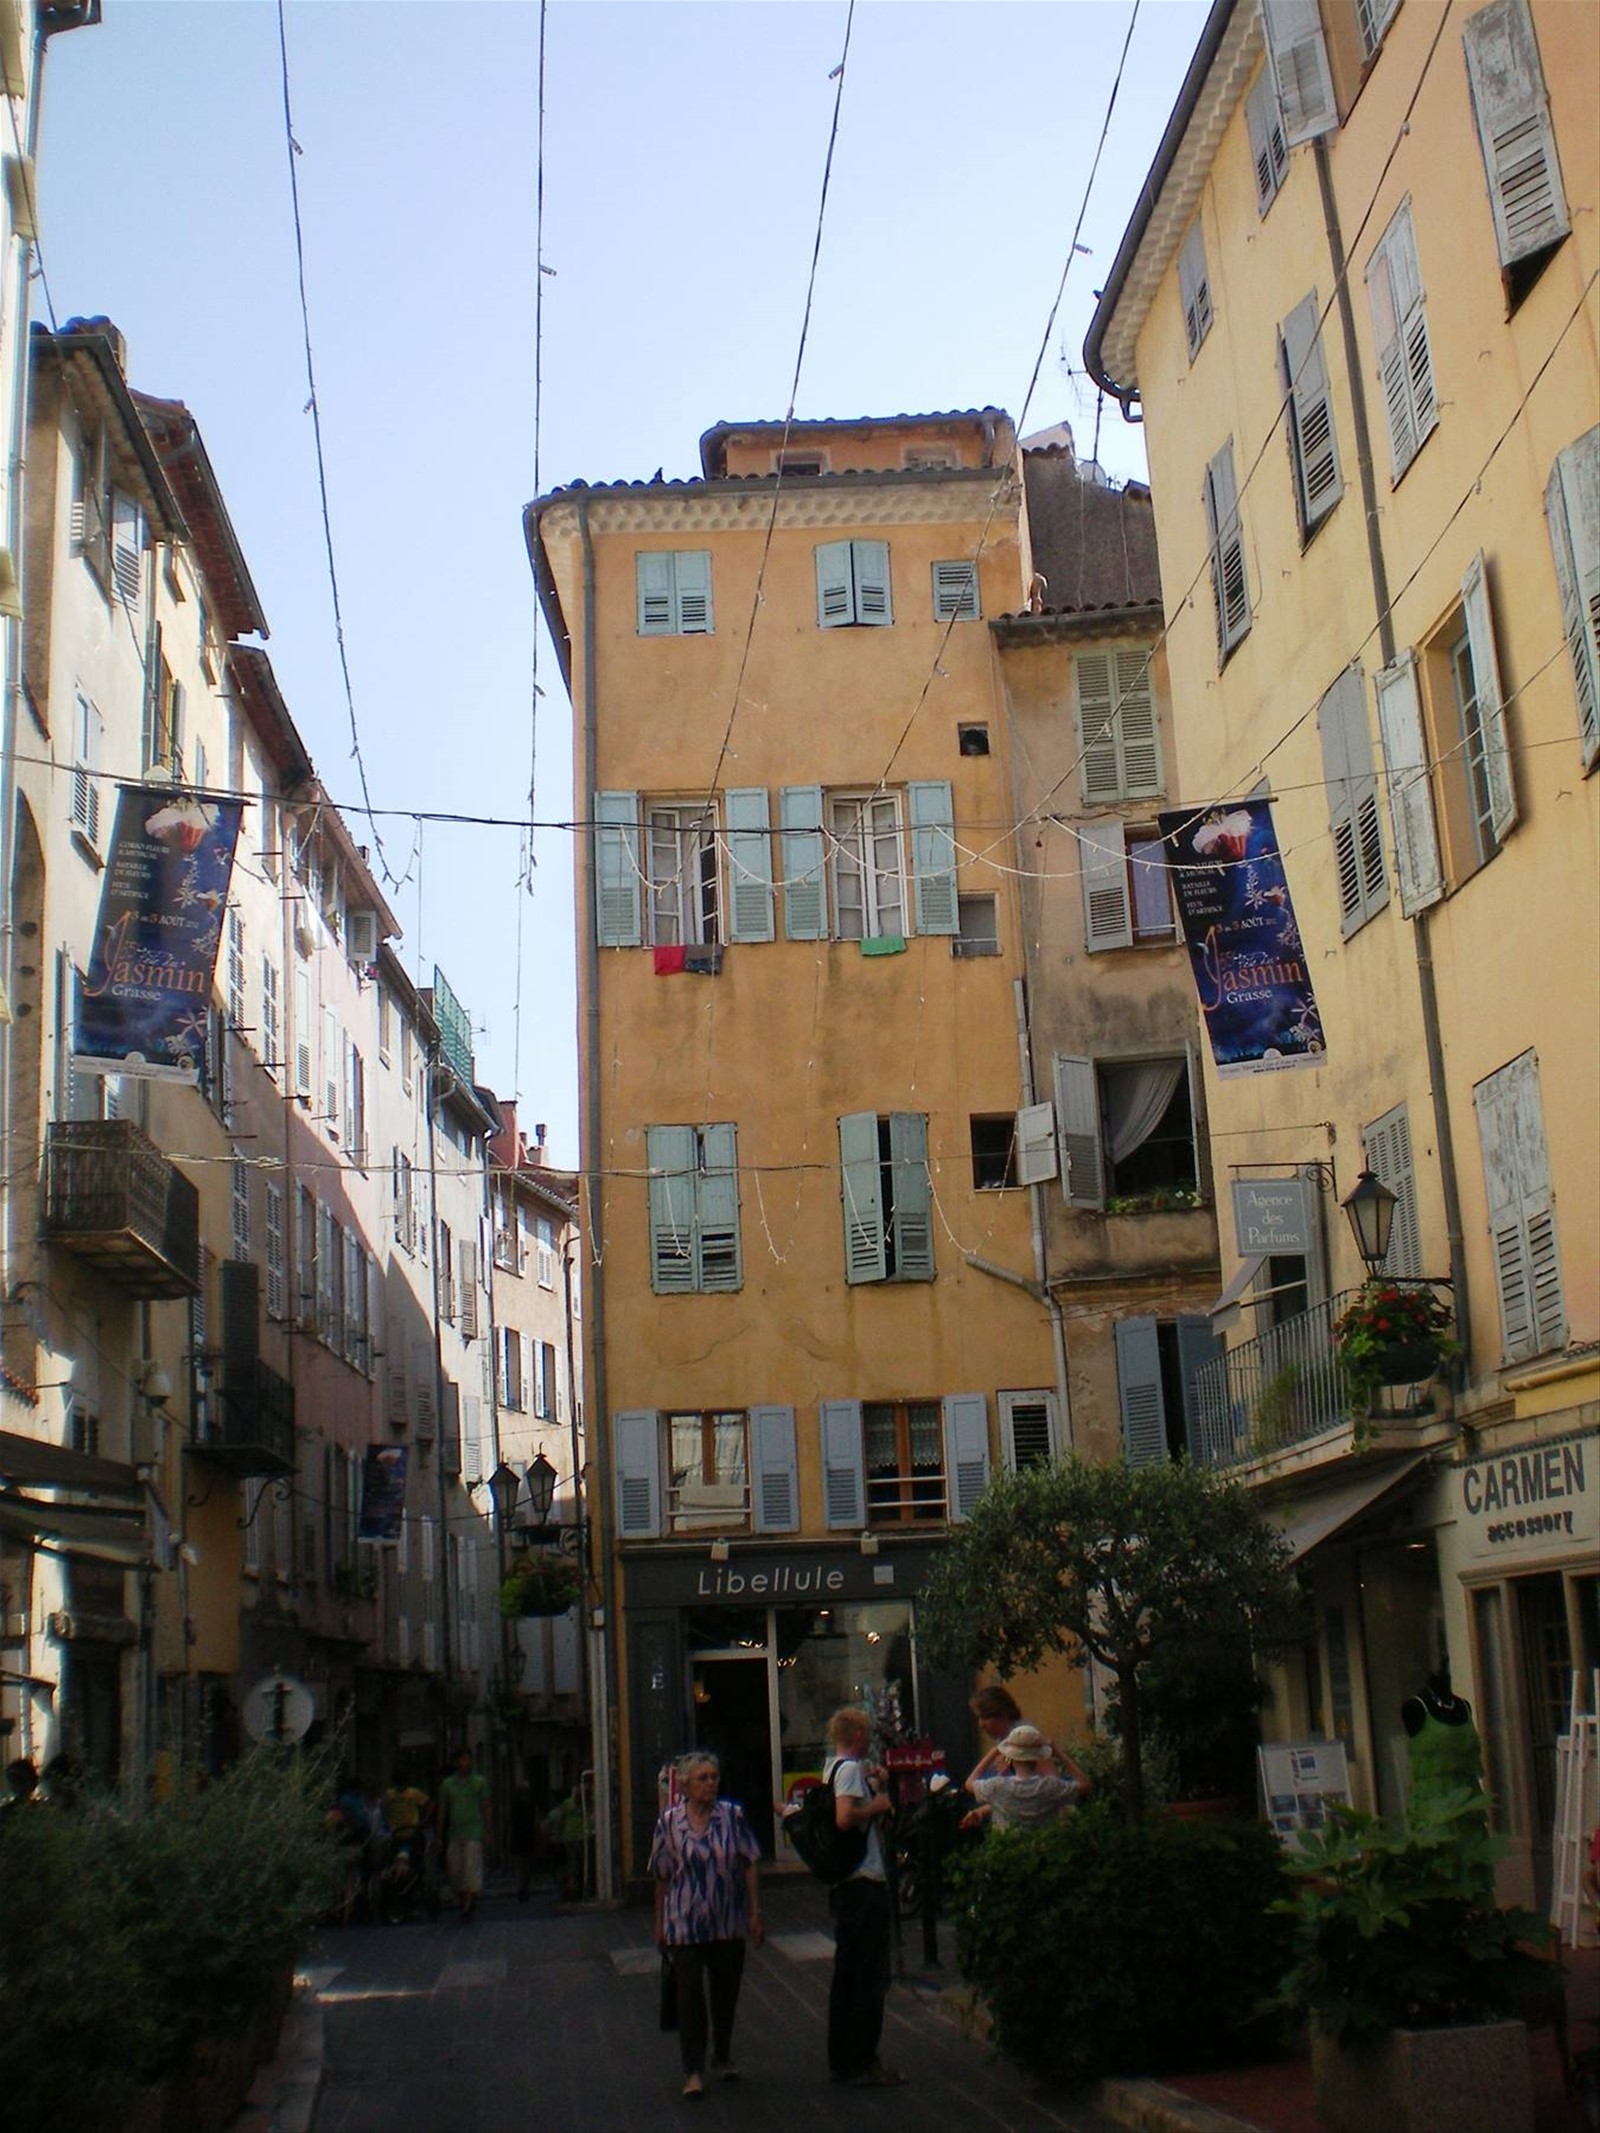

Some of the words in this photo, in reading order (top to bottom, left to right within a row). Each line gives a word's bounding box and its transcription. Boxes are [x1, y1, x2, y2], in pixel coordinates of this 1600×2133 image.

[84, 910, 205, 997] Jasmin
[1202, 926, 1304, 1011] Jasmin
[111, 983, 161, 1000] Grasse
[1226, 988, 1273, 1005] Grasse
[1248, 1190, 1293, 1209] Agence
[1262, 1209, 1284, 1225] des
[1248, 1227, 1300, 1244] Parfums
[1463, 1443, 1586, 1515] CARMEN
[1487, 1510, 1574, 1544] accessory
[698, 1565, 844, 1596] Libellule
